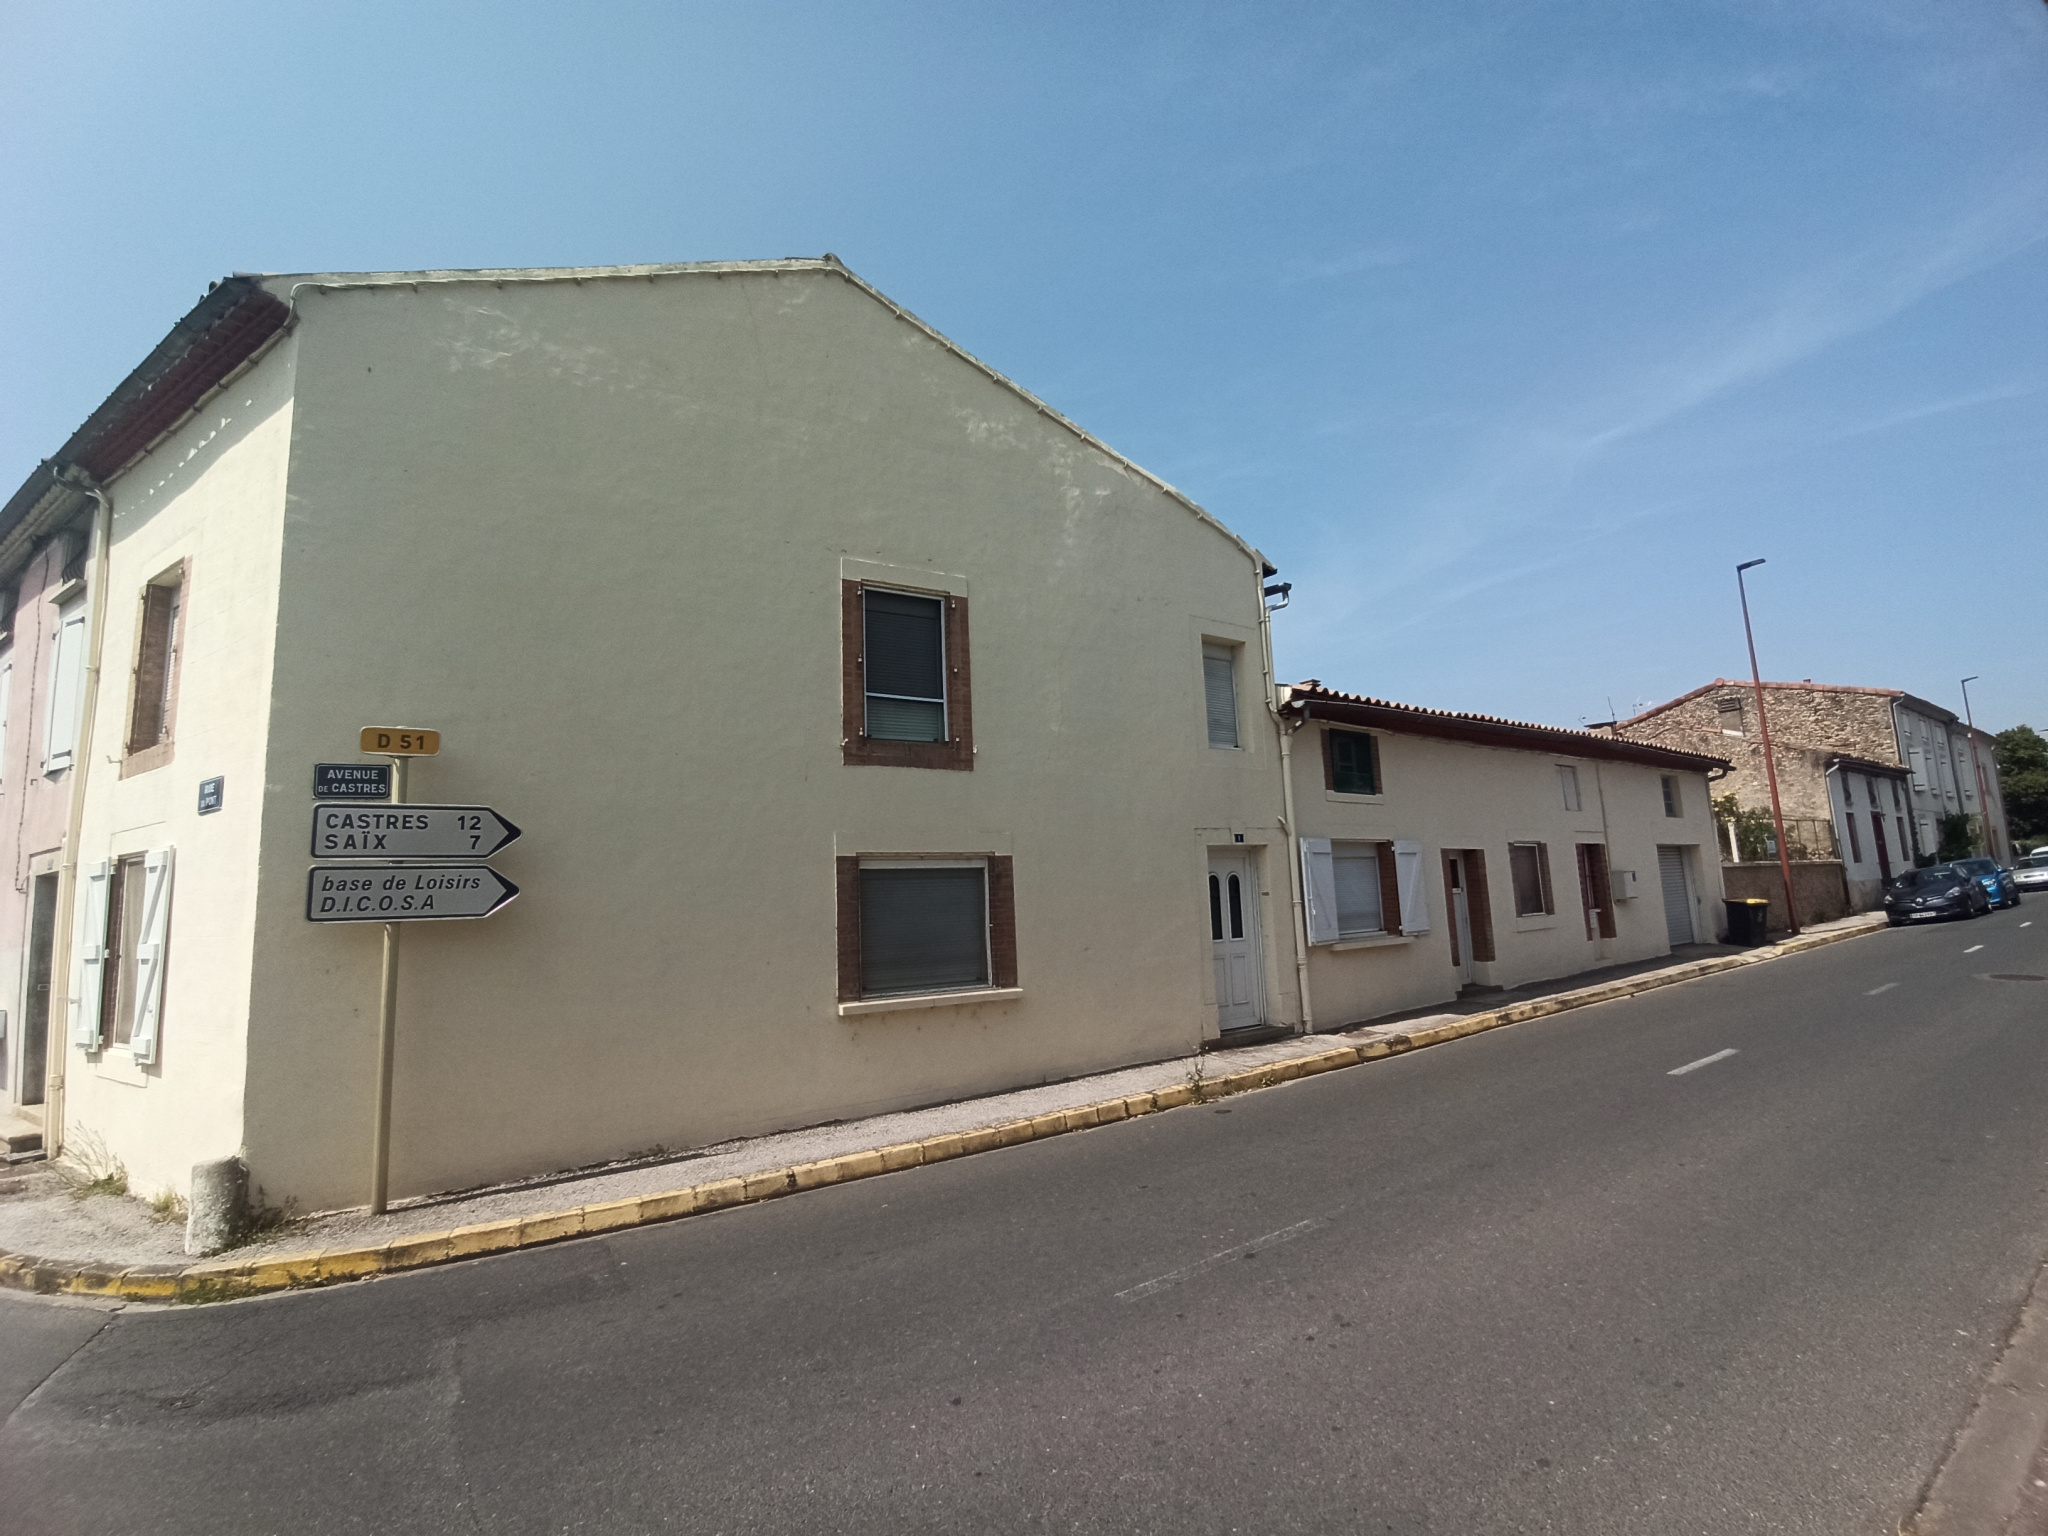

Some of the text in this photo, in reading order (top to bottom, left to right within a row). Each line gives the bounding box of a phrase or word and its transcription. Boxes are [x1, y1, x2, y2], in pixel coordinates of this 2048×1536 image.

[377, 733, 425, 750] D 51
[327, 769, 379, 780] AVENUE
[318, 783, 386, 793] DE CASTRES
[325, 813, 482, 830] CASTRES 12
[324, 831, 481, 850] SAÏX 7
[321, 874, 481, 892] base de Loisirs
[319, 894, 435, 913] D.I.C.O.S.A
